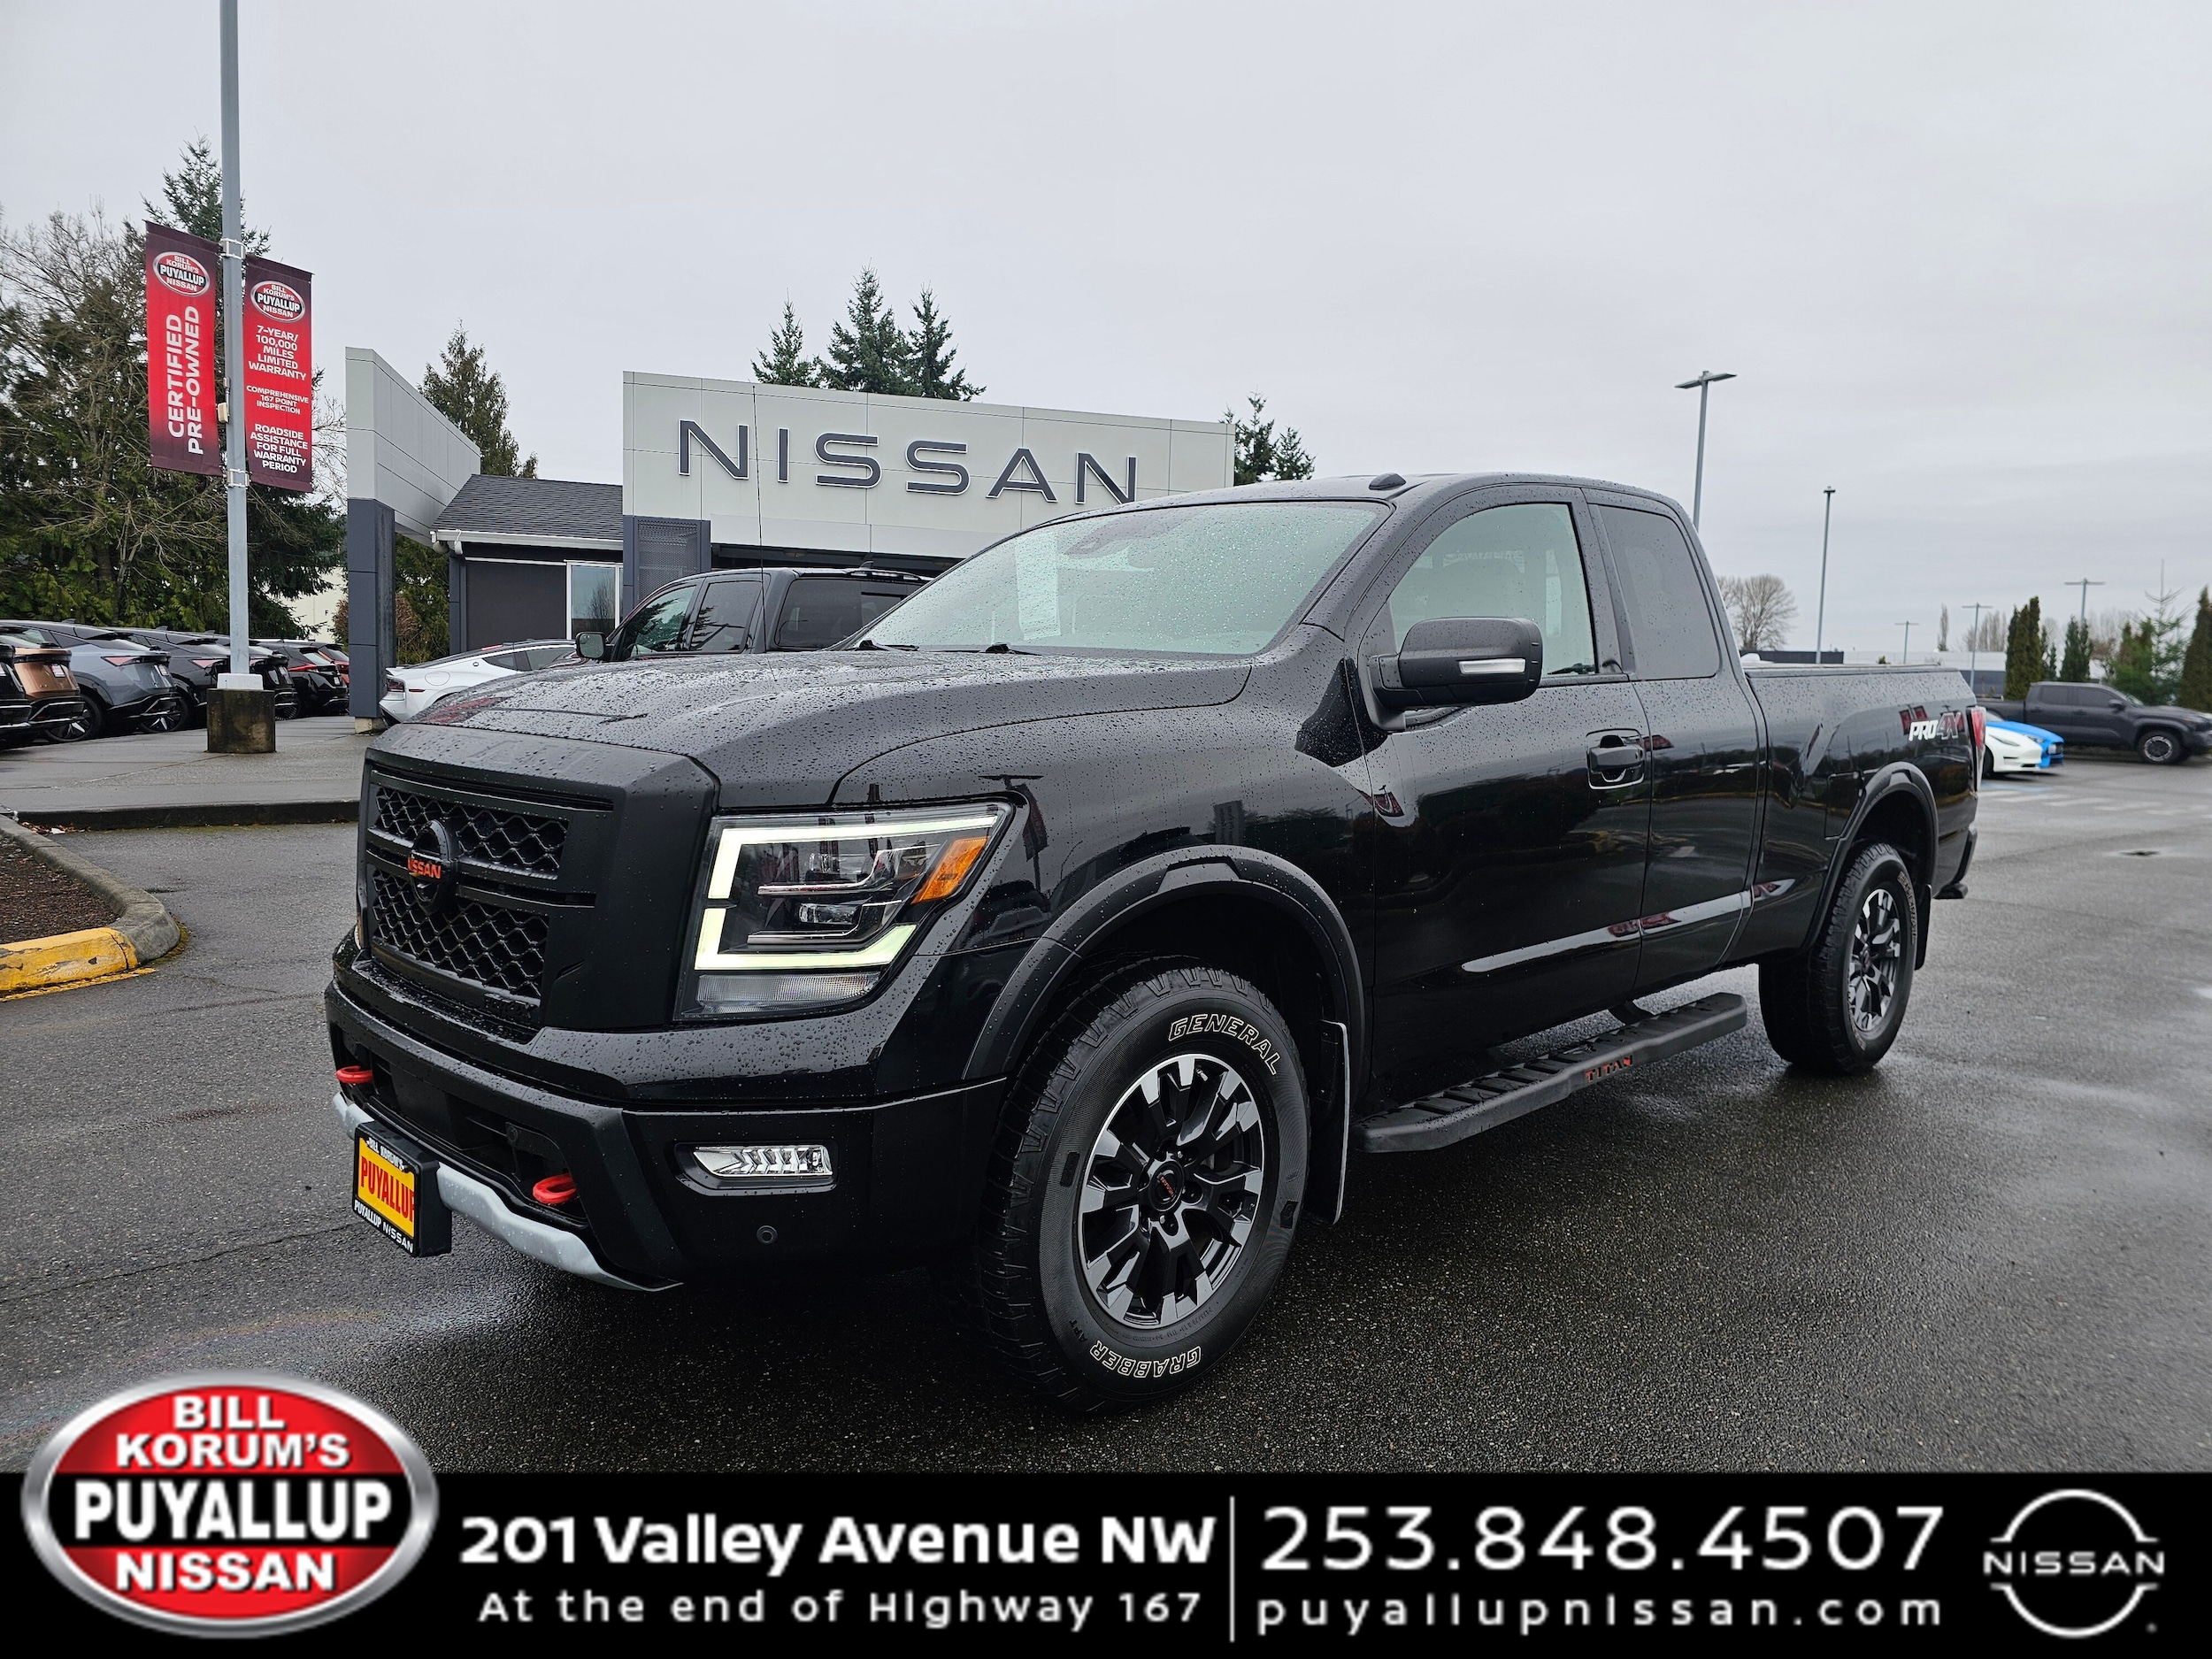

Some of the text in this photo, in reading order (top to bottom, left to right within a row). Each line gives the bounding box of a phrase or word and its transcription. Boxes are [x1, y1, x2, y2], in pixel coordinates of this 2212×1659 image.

[166, 258, 199, 273] KORUM'S
[174, 255, 191, 265] BILL
[160, 265, 204, 286] PUYALLUP
[166, 277, 197, 292] NISSAN
[271, 284, 287, 294] BILL
[257, 293, 300, 311] PUYALLUP
[264, 288, 295, 301] KORUM'S
[263, 305, 294, 318] NISSAN
[257, 325, 298, 341] 7-YEAR/
[256, 334, 297, 350] 100,000
[263, 346, 294, 359] MILES
[258, 353, 298, 369] LIMITED
[165, 314, 184, 438] CERTIFIED
[249, 361, 306, 380] WARRANTY
[184, 306, 204, 455] PRE-OWNED
[246, 385, 309, 404] COMPREHENSIVE
[260, 394, 297, 408] 167 POINT
[257, 400, 301, 415] INSPECTION
[255, 423, 303, 440] ROADSIDE
[250, 432, 308, 449] ASSISTANCE
[253, 449, 306, 466] WARRANTY
[257, 442, 301, 457] FOR FULL
[262, 460, 297, 473] PERIOD
[678, 419, 1137, 504] NISSAN
[1167, 1013, 1282, 1076] GENERAL
[1586, 1055, 1633, 1082] TITAN
[354, 1200, 413, 1254] PUYALLUP NISSAN
[1089, 1340, 1202, 1379] GRABBER
